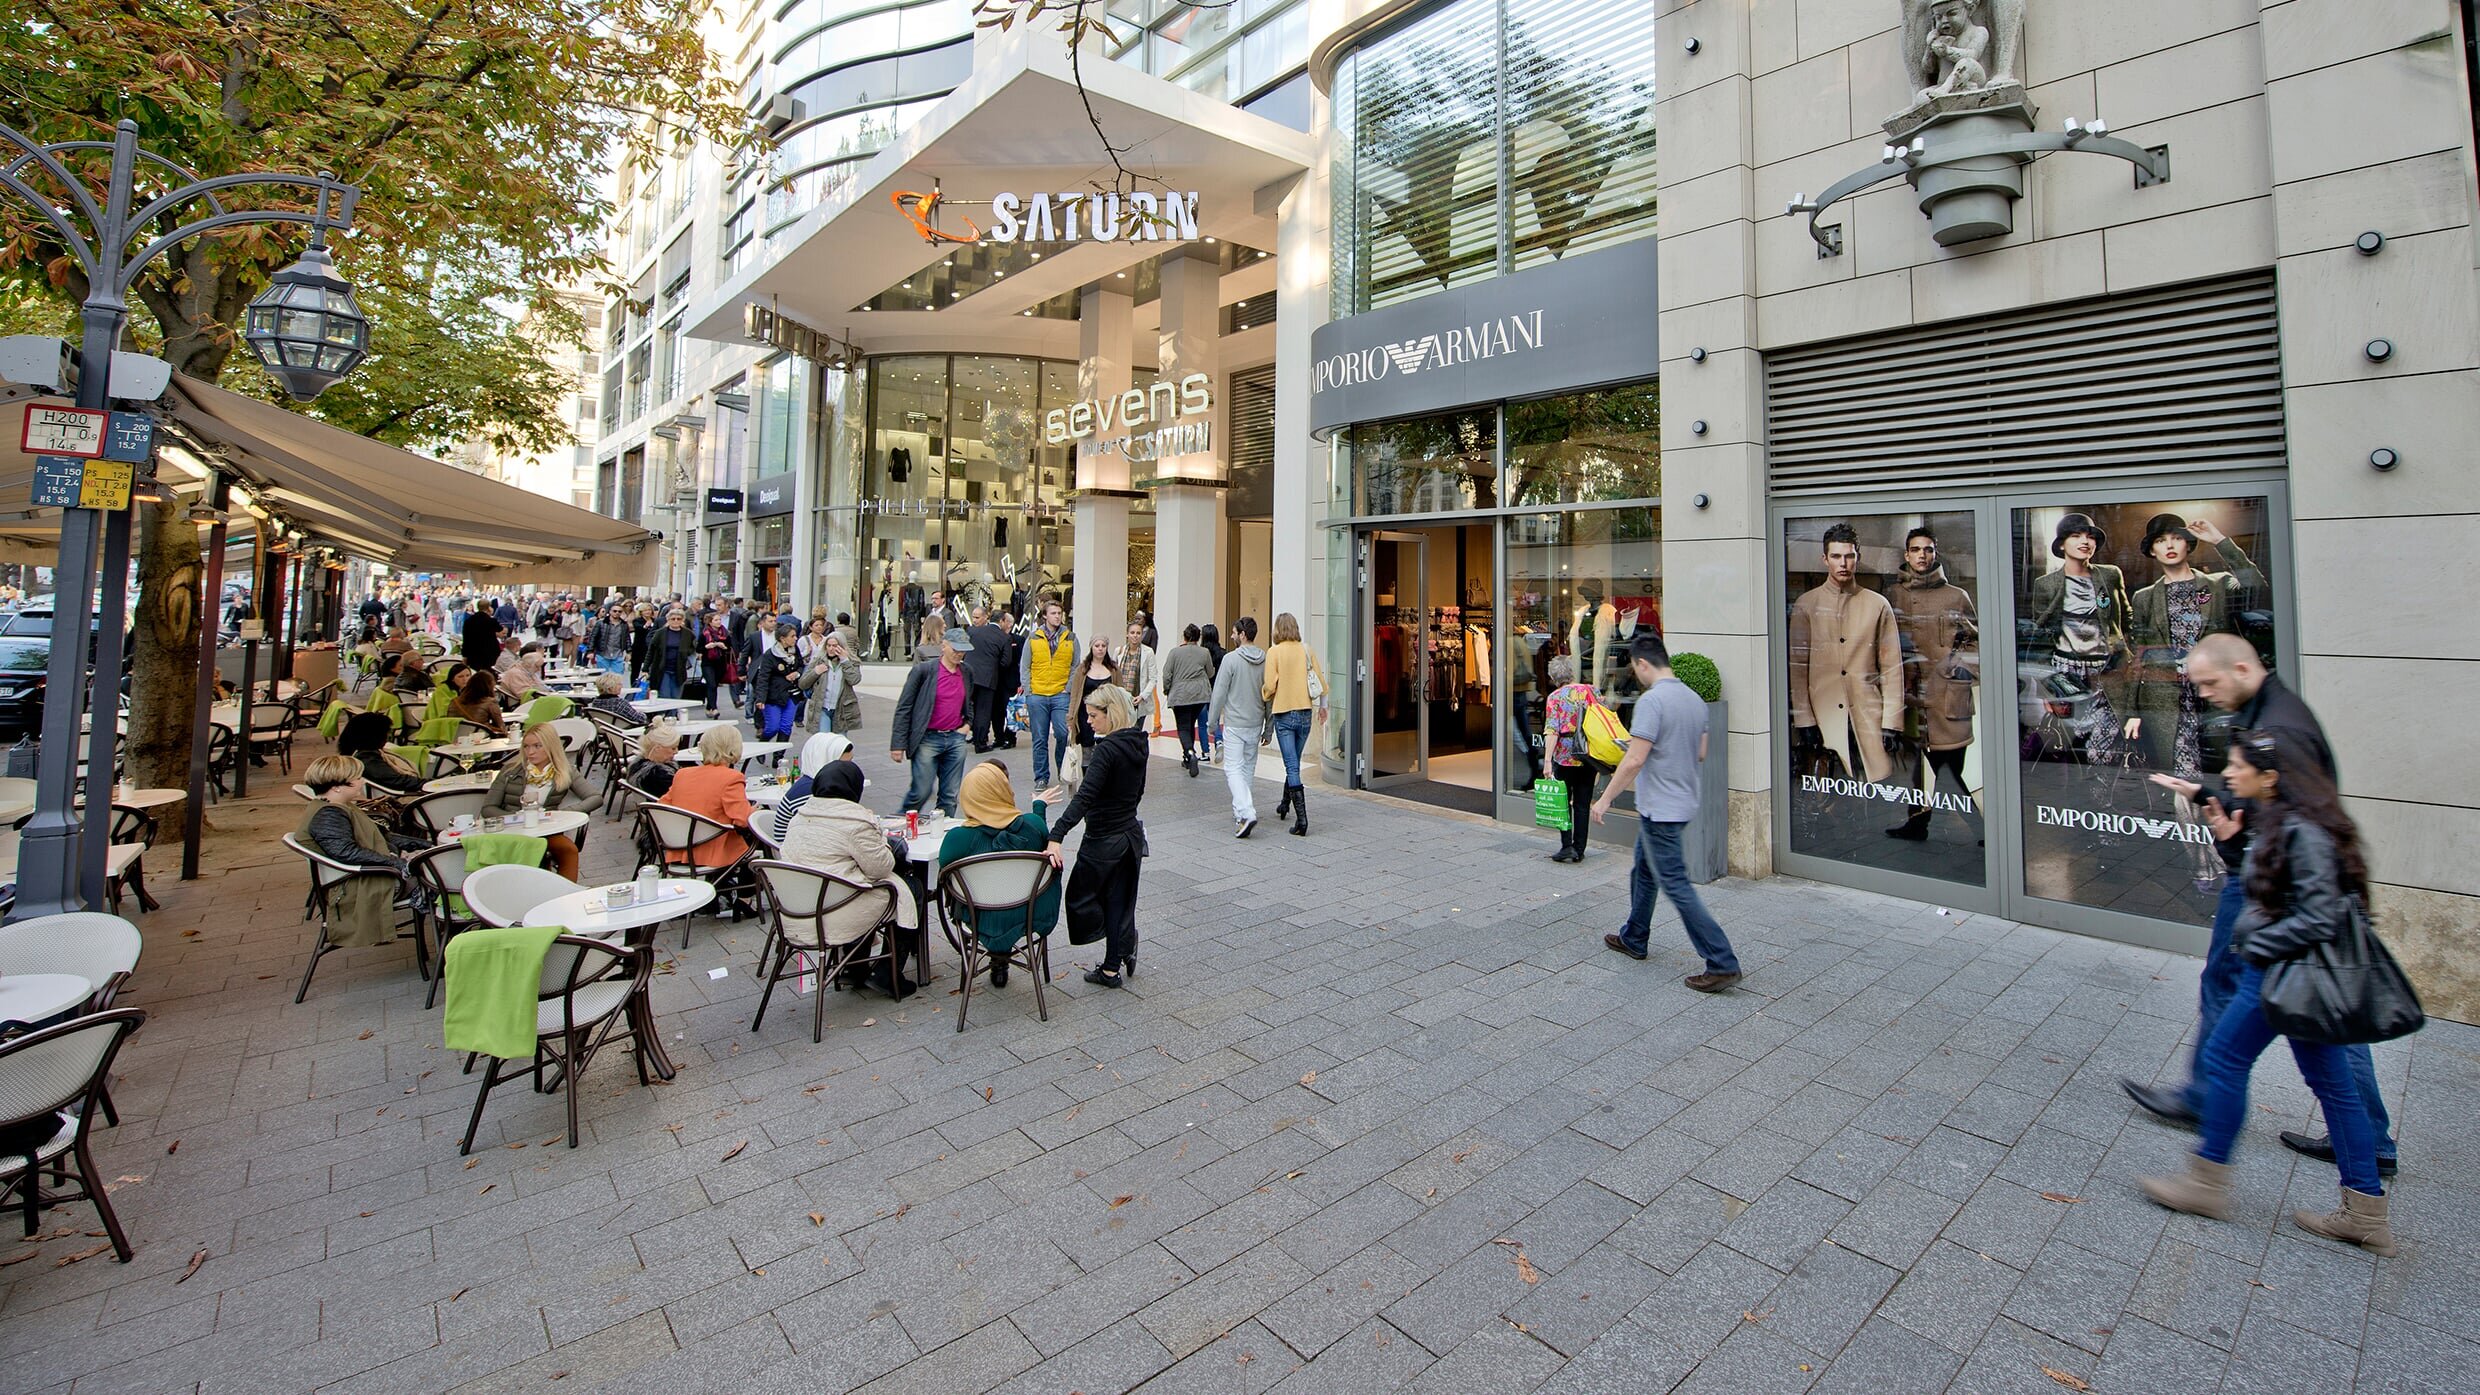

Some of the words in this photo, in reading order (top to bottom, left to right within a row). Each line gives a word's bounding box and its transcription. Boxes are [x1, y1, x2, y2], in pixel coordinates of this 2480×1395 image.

[991, 190, 1200, 244] SATURN
[1426, 309, 1544, 370] ARMANI
[1046, 372, 1212, 445] sevens
[132, 423, 150, 432] 200
[79, 428, 98, 441] 0.9
[134, 433, 148, 442] 0.9
[1146, 421, 1211, 461] SATURN
[36, 465, 49, 474] PS
[63, 467, 82, 476] 150
[85, 469, 97, 478] PS
[112, 471, 130, 480] 125
[57, 495, 70, 504] 58
[106, 499, 119, 507] 58
[1801, 774, 1877, 800] EMPORIO
[1899, 787, 1973, 814] ARMANI
[2036, 804, 2138, 836] EMPORIO
